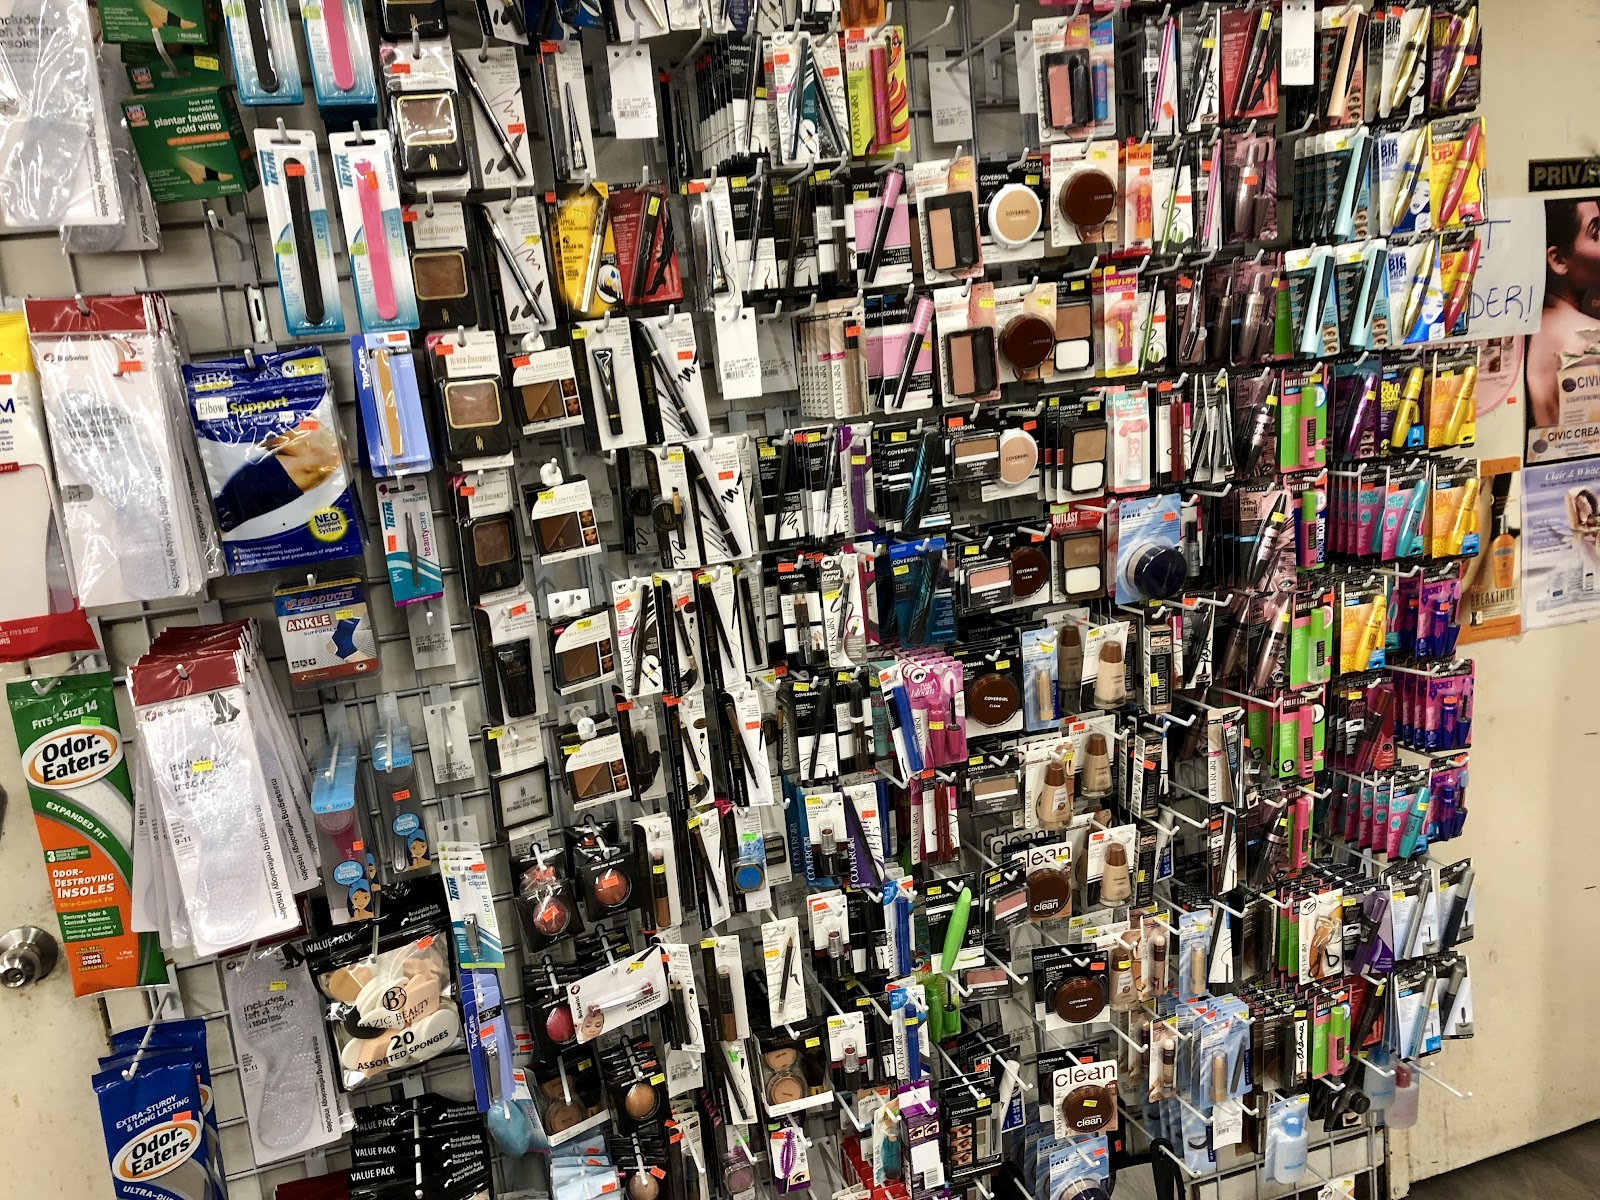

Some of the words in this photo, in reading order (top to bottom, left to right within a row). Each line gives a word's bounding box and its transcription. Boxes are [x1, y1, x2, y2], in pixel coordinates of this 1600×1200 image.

[0, 14, 45, 25] ncludes
[1386, 14, 1401, 34] BIG
[154, 116, 186, 128] plantar
[176, 124, 197, 134] cold
[198, 121, 222, 132] wrap
[852, 93, 862, 148] COVERGIRL
[1381, 142, 1398, 157] BIG
[980, 173, 1010, 182] COVERGIRL
[1534, 163, 1600, 187] PRIVA
[1389, 255, 1407, 269] BIG
[1106, 279, 1121, 287] BABY
[1121, 277, 1137, 285] LIPS
[354, 346, 370, 390] TopCare
[1577, 377, 1600, 388] CIVI
[200, 399, 225, 414] Elbow
[230, 396, 289, 415] Support
[1060, 403, 1085, 411] COVERGIRL
[947, 424, 976, 433] COVERGIRL
[1548, 430, 1573, 442] CIVIC
[887, 447, 915, 456] COVERGIRL
[1005, 453, 1030, 461] COVERGIRL
[1545, 470, 1566, 481] Clair
[1568, 468, 1575, 477] &
[402, 495, 428, 504] tweezers
[313, 511, 340, 526] NEO
[383, 499, 395, 531] TRIM
[1052, 511, 1078, 524] OUTLAST
[316, 520, 341, 530] Support
[317, 525, 343, 535] System
[416, 511, 432, 557] beautycare
[239, 552, 262, 560] Effective
[284, 546, 303, 555] support
[283, 550, 311, 561] prevention
[318, 546, 343, 556] injuries
[892, 556, 922, 565] COVERGIRL
[962, 554, 988, 563] COVERGIRL
[1016, 567, 1039, 575] COVERGIRL
[297, 590, 353, 606] PRODUCTS
[1470, 588, 1515, 608] BREAKTHRU
[286, 614, 332, 632] ANKLE
[829, 616, 838, 666] COVERGIRL
[1158, 655, 1167, 679] STUDIO
[1156, 678, 1167, 705] TATTOO
[32, 716, 53, 730] FITS
[63, 707, 84, 721] SIZE
[84, 699, 99, 713] 14
[42, 734, 101, 763] Odor-
[42, 750, 110, 783] Eaters
[391, 759, 410, 767] SAVVY
[967, 764, 996, 774] COVERGIRL
[1209, 758, 1217, 803] COVERGIRL
[315, 804, 328, 812] SPA
[332, 801, 352, 810] SAVVY
[46, 802, 94, 830] EXPANDED
[93, 825, 109, 841] FIT
[270, 778, 289, 820] massaging
[282, 820, 300, 859] reflexology
[297, 858, 309, 881] insoles
[174, 835, 192, 846] 9-11
[793, 822, 801, 868] COVERGIRL
[911, 812, 920, 864] COVERGIRL
[47, 850, 56, 863] 3
[254, 804, 270, 850] massaging
[265, 850, 280, 890] reflexology
[275, 890, 288, 920] insoles
[805, 836, 815, 882] COVERGIRL
[850, 836, 860, 884] COVERGIRL
[52, 869, 84, 879] ODOR-
[337, 869, 364, 880] brush
[338, 864, 357, 873] facial
[54, 873, 114, 888] DESTROYING
[57, 883, 115, 899] INSOLES
[446, 876, 460, 901] TRIM
[482, 895, 491, 913] care
[1033, 900, 1059, 912] clean
[63, 912, 87, 921] Destroys
[87, 910, 102, 918] Odor
[307, 938, 333, 954] VALUE
[82, 958, 102, 966] ODOR
[1046, 962, 1073, 973] COVERGIRL
[1068, 996, 1094, 1005] COVERGIRL
[358, 1015, 392, 1029] BAZIC
[395, 997, 430, 1021] BEAUTY
[470, 1013, 479, 1050] TopCare
[391, 1030, 415, 1051] 20
[312, 1035, 323, 1077] massaging
[357, 1047, 407, 1071] ASSORTED
[407, 1030, 450, 1055] SPONGES
[896, 1035, 904, 1075] COVERGIRL
[1038, 1056, 1065, 1065] COVERGIRL
[243, 1064, 258, 1073] 9-11
[1055, 1063, 1116, 1088] clean
[317, 1077, 328, 1112] reflexology
[115, 1094, 177, 1130] EXTRA-STURDY
[126, 1124, 133, 1132] &
[133, 1112, 156, 1129] LONG
[156, 1096, 190, 1118] LASTING
[951, 1107, 977, 1116] COVERGIRL
[322, 1112, 334, 1134] insoles
[377, 1116, 396, 1128] PACK
[1076, 1116, 1103, 1128] clean
[131, 1128, 183, 1161] Odor-
[355, 1146, 377, 1157] VALUE
[377, 1145, 396, 1155] PACK
[131, 1137, 190, 1178] Eaters
[351, 1170, 375, 1182] VALUE
[376, 1166, 396, 1177] PACK
